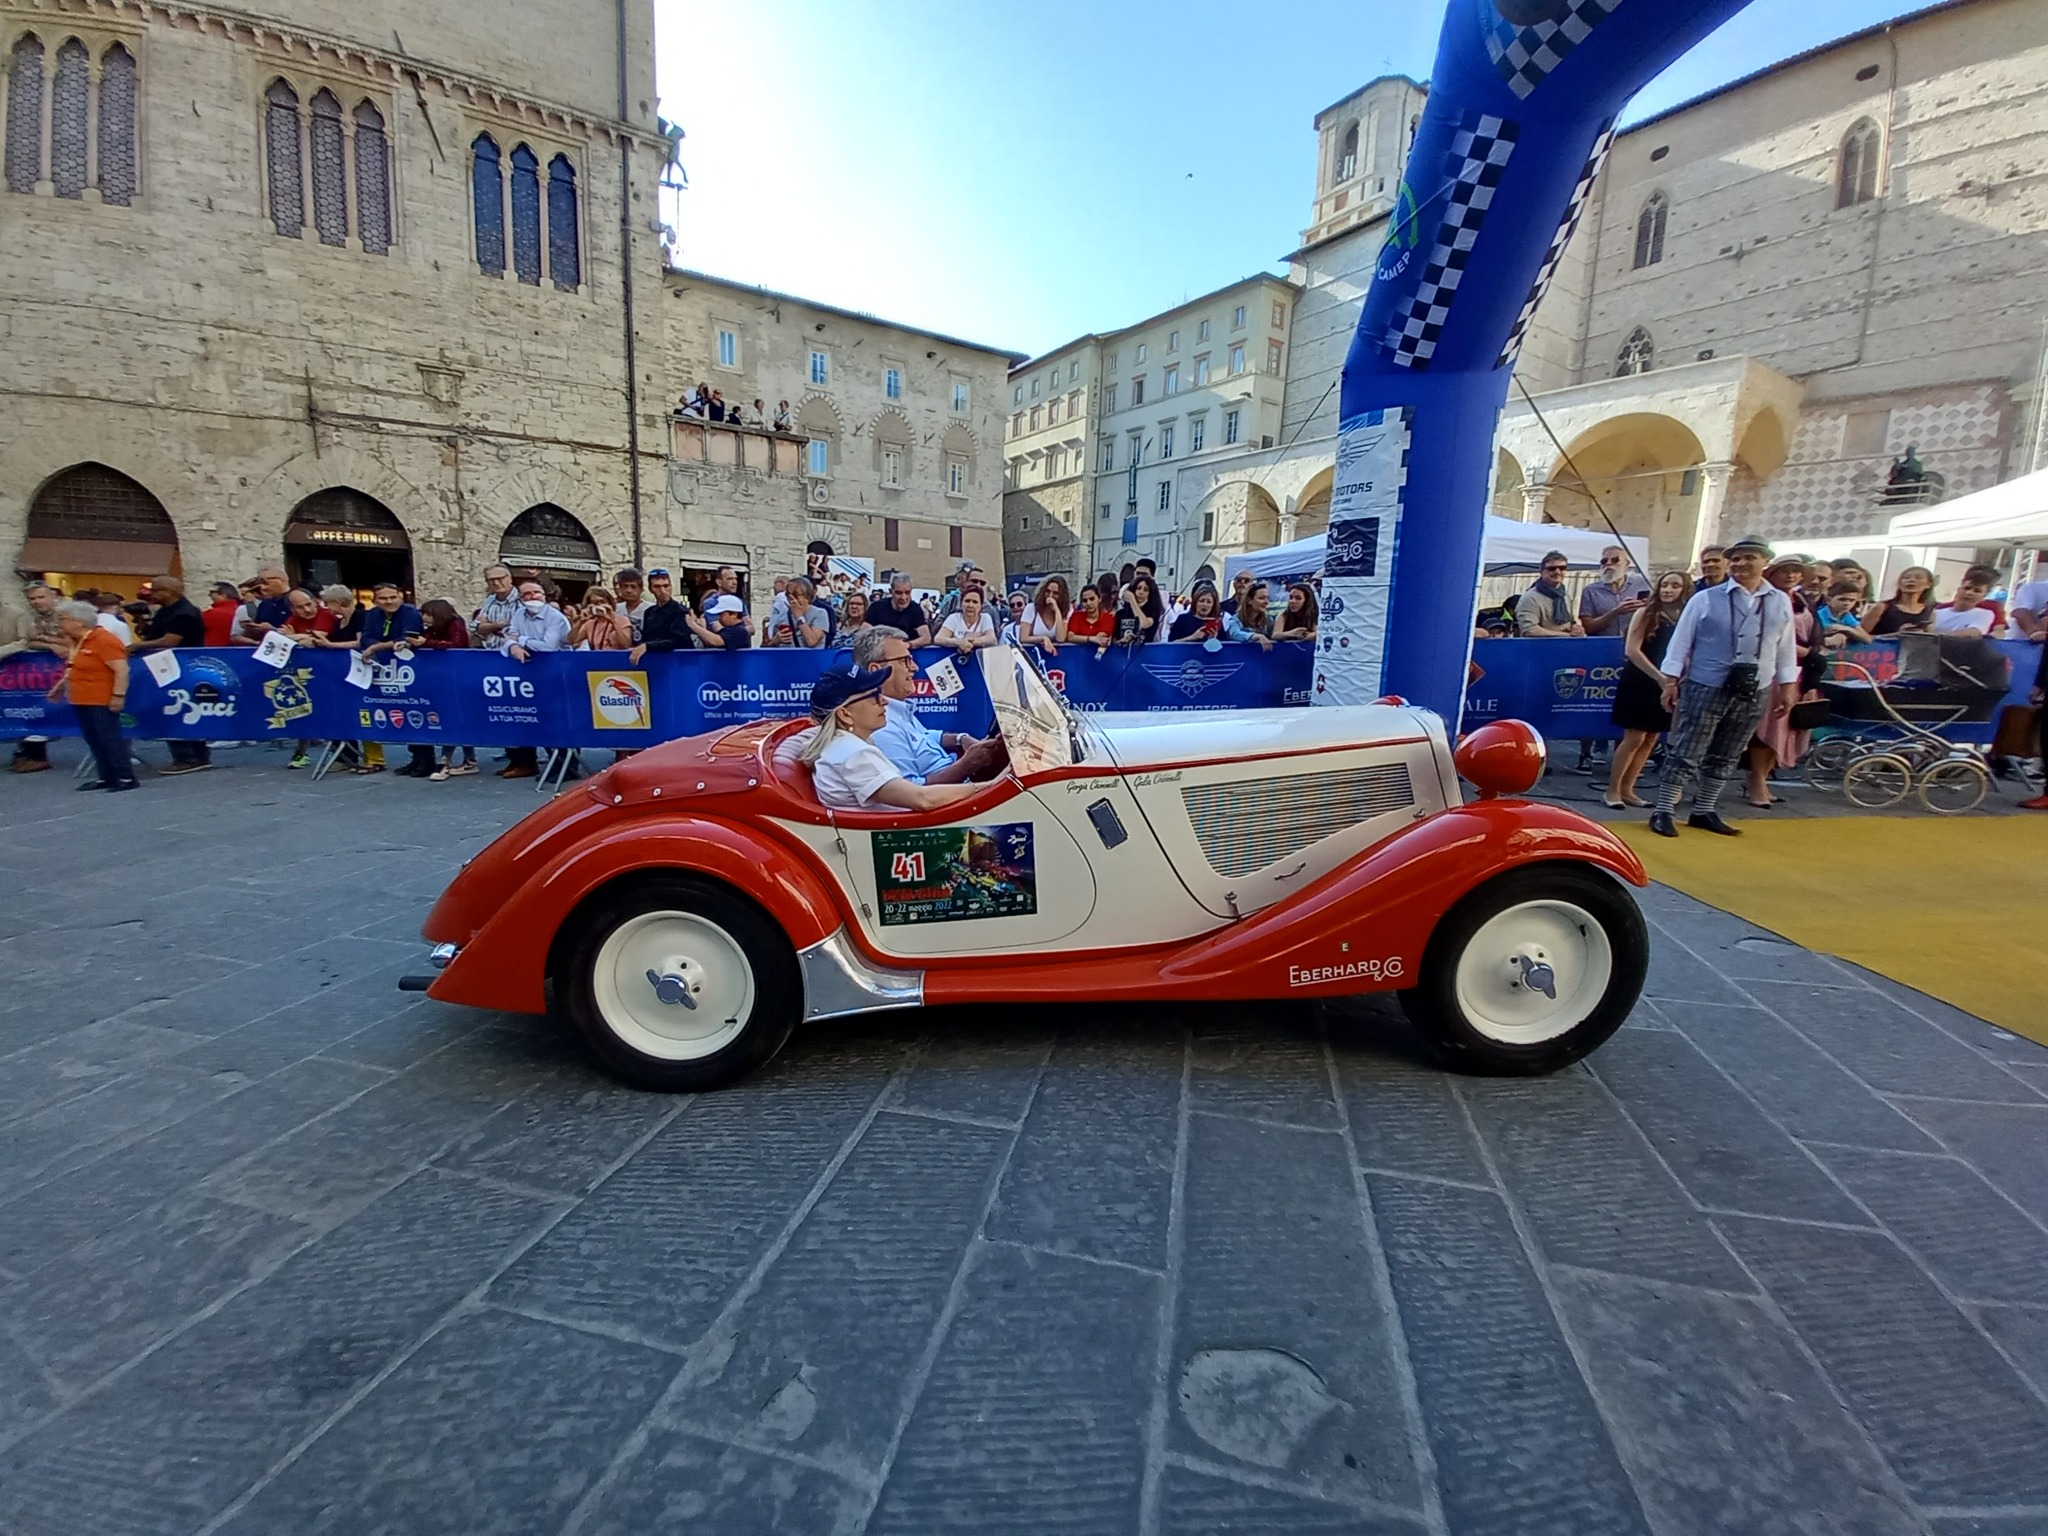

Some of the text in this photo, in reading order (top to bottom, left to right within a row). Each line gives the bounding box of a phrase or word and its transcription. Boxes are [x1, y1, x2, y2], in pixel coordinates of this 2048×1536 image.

[1378, 251, 1411, 281] CAMEP
[163, 689, 238, 725] Baci
[488, 705, 538, 714] ASSICURIAMO
[891, 851, 926, 882] 41
[1289, 960, 1381, 984] EBERHARD
